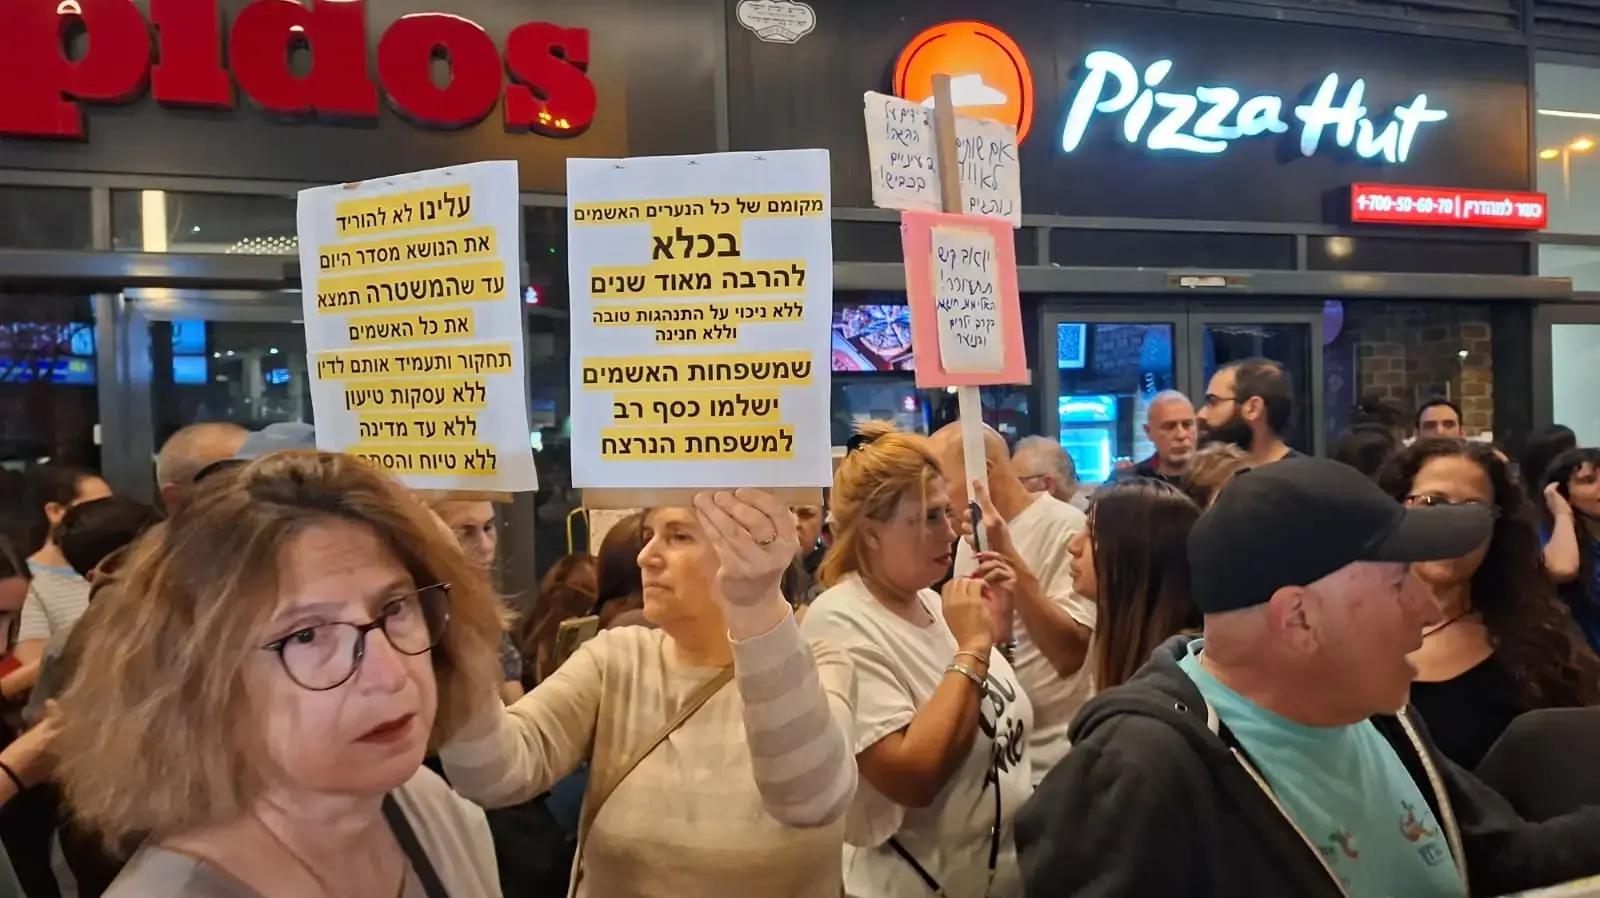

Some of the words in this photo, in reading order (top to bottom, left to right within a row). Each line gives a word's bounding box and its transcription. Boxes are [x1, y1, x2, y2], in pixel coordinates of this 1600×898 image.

[1062, 50, 1288, 155] Pizza
[1294, 72, 1448, 164] Hut
[989, 140, 1016, 165] אם
[880, 165, 926, 192] בכביש!
[393, 204, 412, 223] לא
[420, 192, 470, 220] עלינו
[575, 207, 639, 220] האשמים
[647, 204, 703, 217] הנערים
[711, 199, 729, 214] כל
[737, 198, 760, 213] של
[768, 200, 822, 215] מקומם
[1515, 202, 1543, 218] כשר
[336, 207, 385, 230] להוריד
[407, 240, 457, 259] הנושא
[464, 236, 489, 252] את
[653, 227, 740, 260] בכלא
[320, 253, 350, 268] היום
[357, 247, 399, 264] מסדר
[592, 276, 645, 293] שנים
[655, 273, 711, 290] מאוד
[723, 264, 804, 288] להרבה
[367, 278, 473, 303] שהמשטרה
[482, 277, 503, 293] עד
[318, 291, 360, 307] תמצא
[593, 312, 629, 322] טובה
[637, 309, 703, 321] התנהגות
[710, 305, 728, 320] על
[736, 307, 766, 318] ניכוי
[774, 302, 802, 317] ללא
[349, 323, 413, 340] האשמים
[419, 316, 437, 334] כל
[444, 318, 468, 333] את
[703, 324, 736, 339] וללא
[656, 329, 696, 340] חנינה
[318, 357, 344, 379] לדין
[351, 359, 389, 372] אותם
[395, 356, 451, 371] ותעמיד
[458, 353, 511, 373] תחקור
[688, 361, 810, 381] שמשפחות
[584, 366, 677, 383] האשמים
[346, 390, 383, 410] טיעון
[391, 388, 444, 408] עסקות
[453, 381, 485, 402] ללא
[614, 403, 642, 418] רב
[654, 401, 700, 423] כסף
[711, 394, 778, 416] ישלמו
[360, 422, 407, 436] מדינה
[414, 422, 435, 437] עד
[444, 416, 476, 436] ללא
[602, 437, 674, 454] הנרצח
[685, 429, 792, 452] למשפחת
[420, 455, 456, 469] טיוח
[464, 449, 496, 469] ללא
